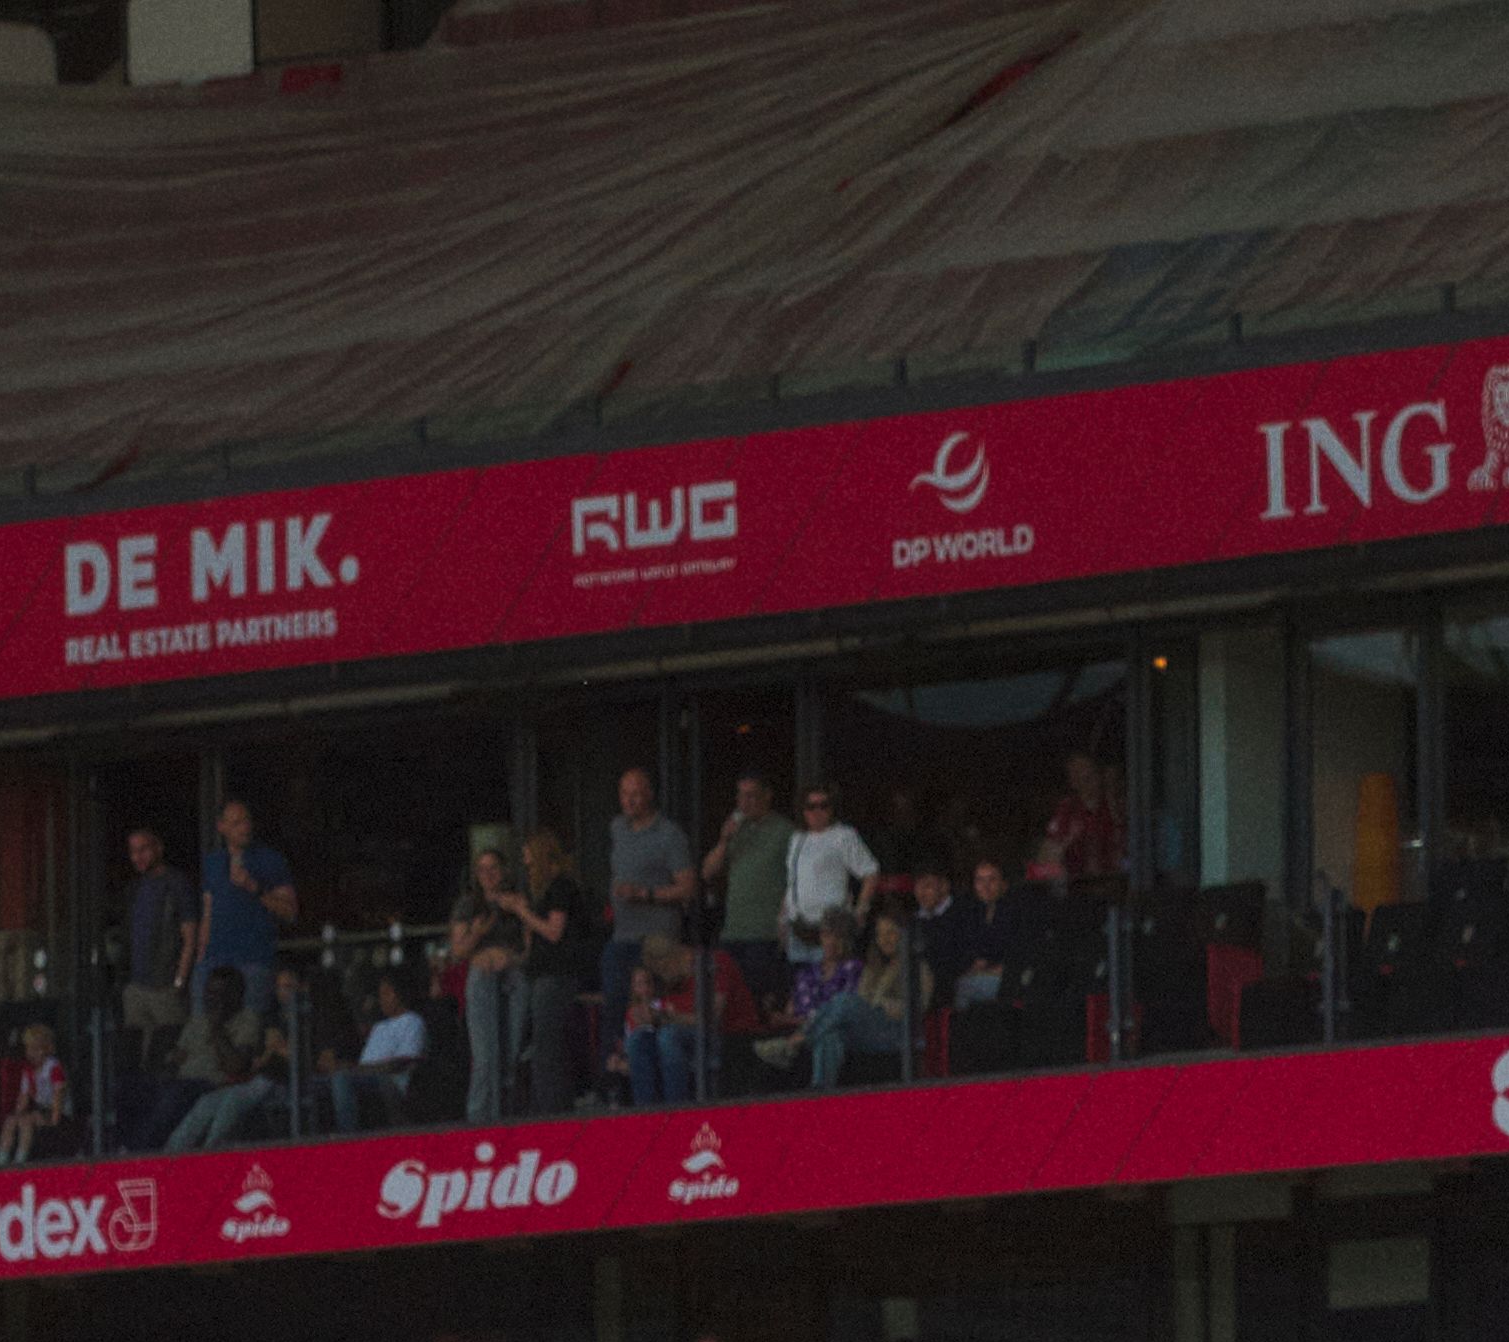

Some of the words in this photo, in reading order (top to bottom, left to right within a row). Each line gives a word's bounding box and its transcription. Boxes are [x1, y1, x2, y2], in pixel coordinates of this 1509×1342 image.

[1258, 401, 1454, 520] ING
[571, 480, 739, 556] RWG
[892, 537, 931, 569] DP
[931, 524, 1035, 563] WORLD
[64, 537, 159, 617] DE
[190, 513, 360, 602] MIK.
[64, 634, 126, 665] REAL
[127, 623, 212, 659] ESTATE
[215, 609, 338, 647] PARTNERS
[377, 1142, 578, 1228] Spido
